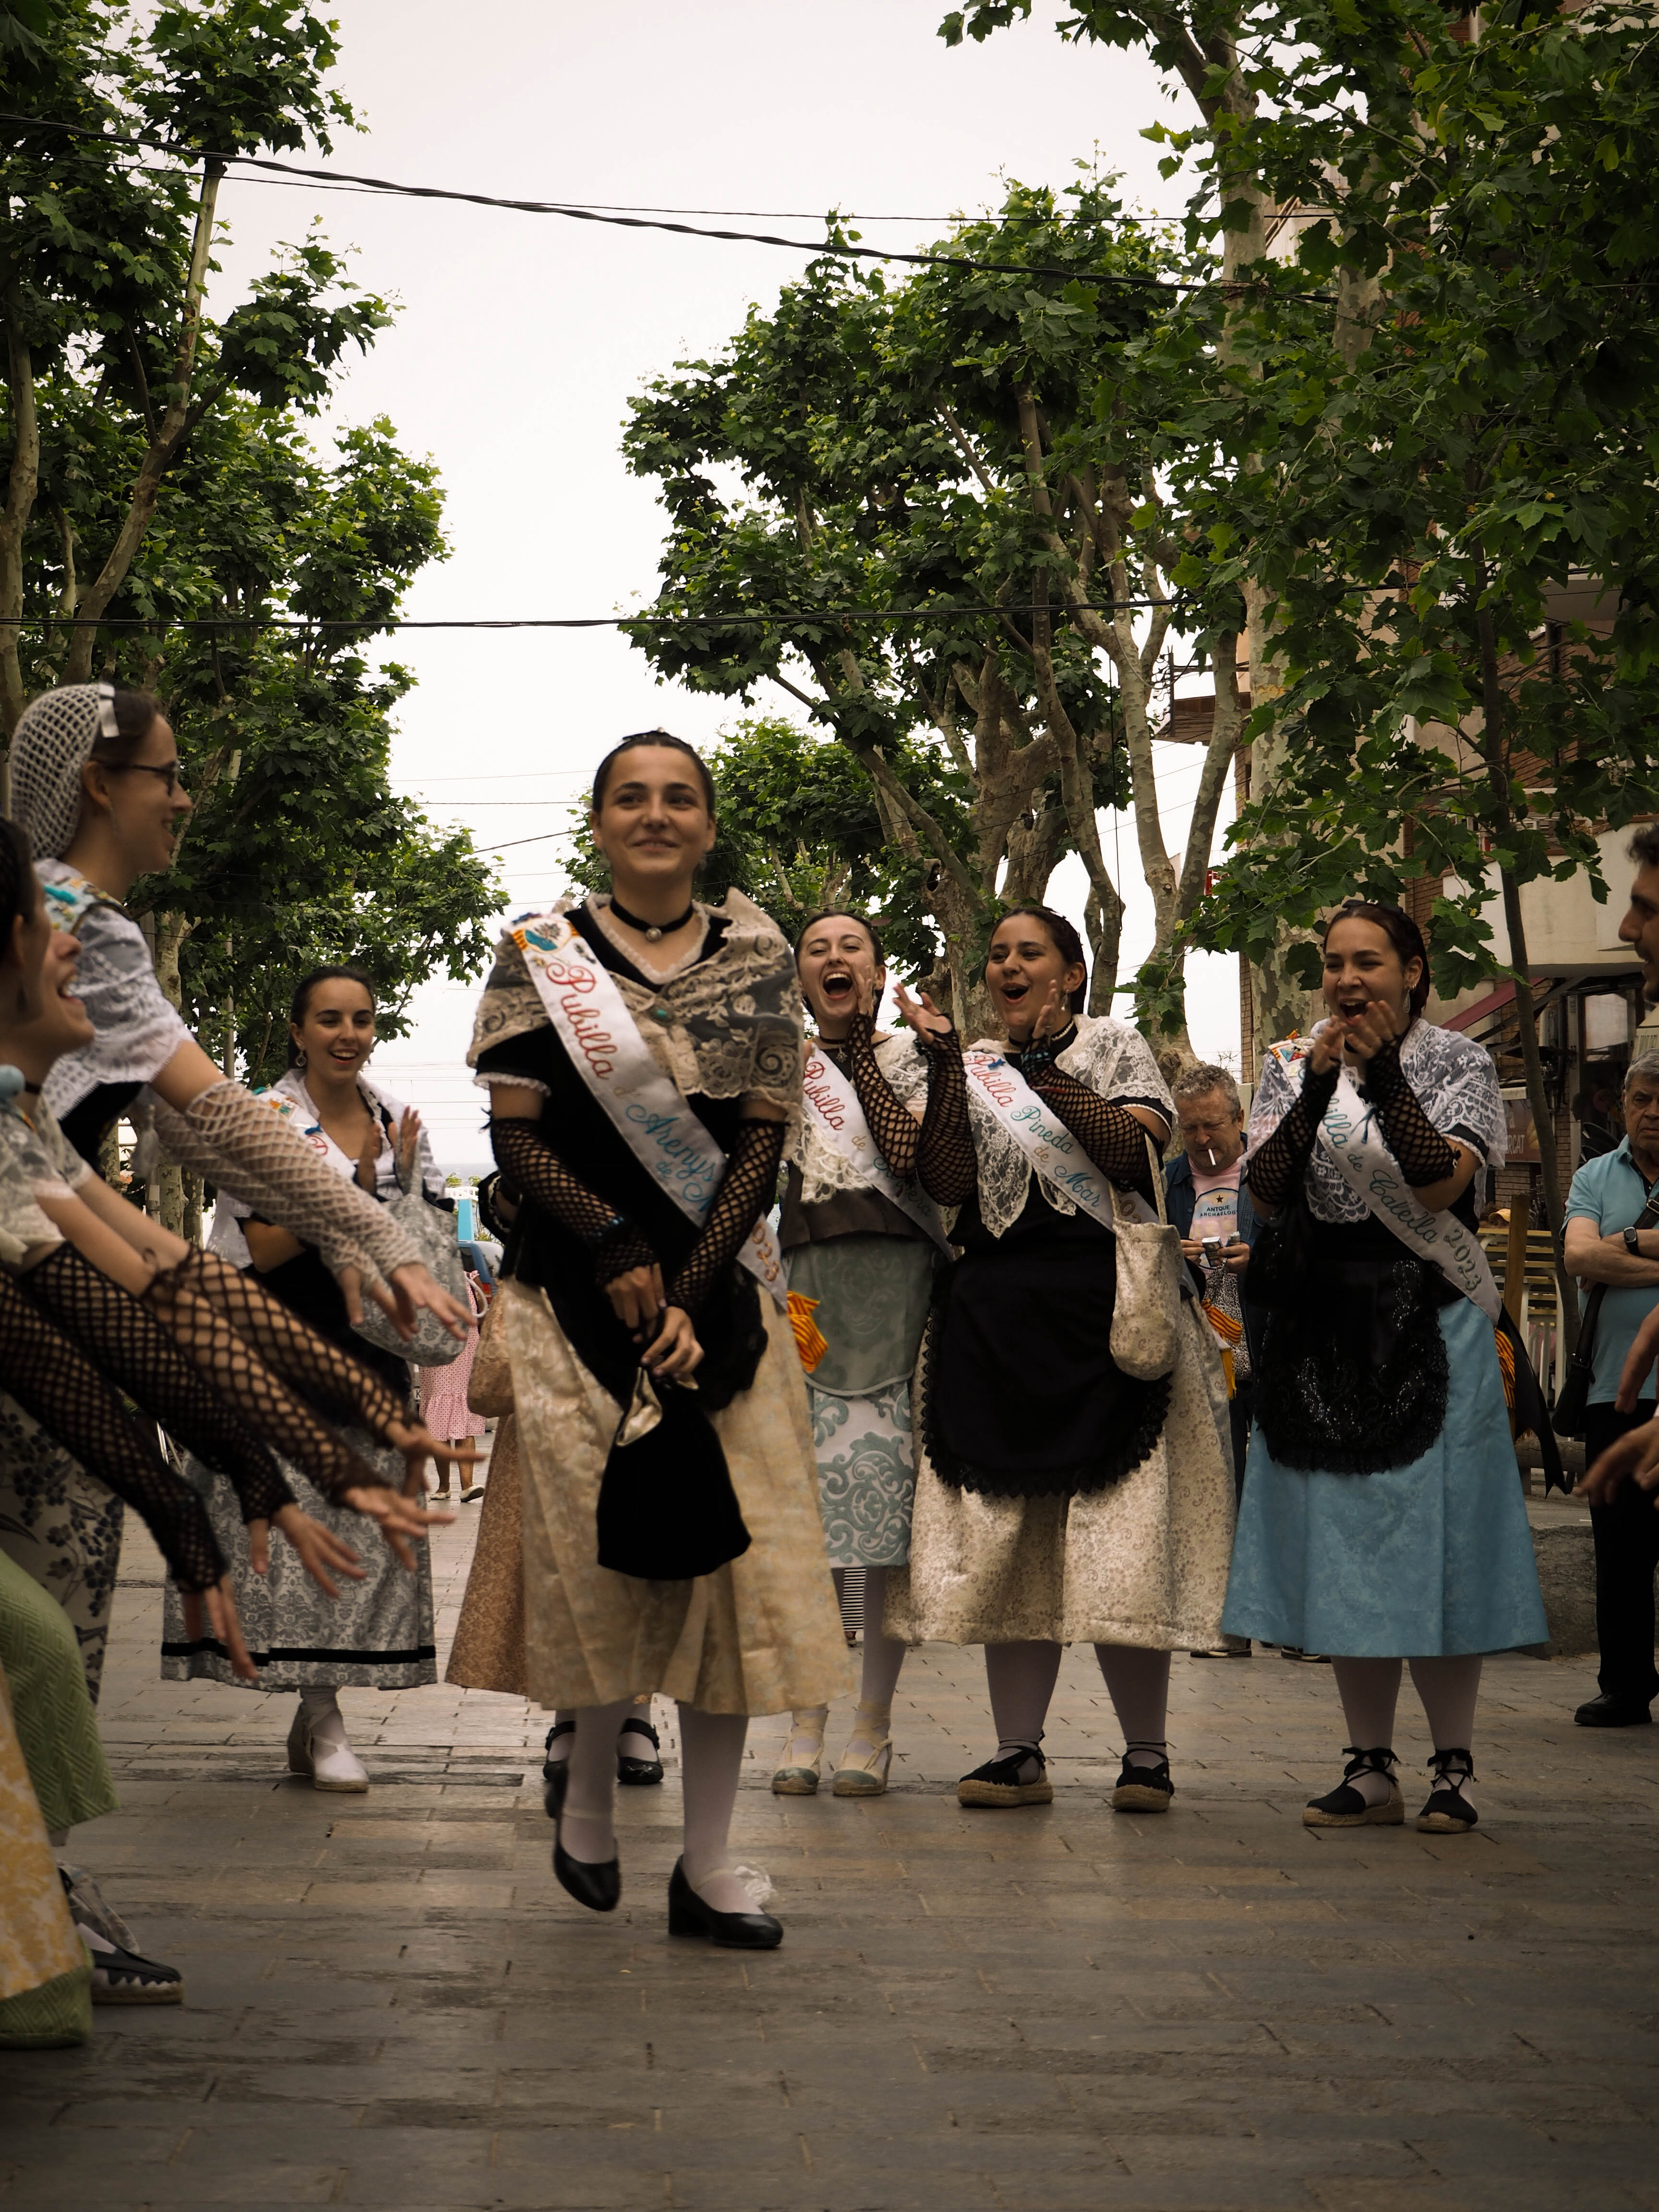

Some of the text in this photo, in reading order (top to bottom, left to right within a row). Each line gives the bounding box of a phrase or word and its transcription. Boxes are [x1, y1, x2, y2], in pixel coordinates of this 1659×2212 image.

[546, 963, 618, 1081] Pubilla
[803, 1061, 845, 1130] Pubilla
[852, 1136, 866, 1151] de
[962, 1055, 1016, 1107] Pubilla
[625, 1105, 715, 1181] Arenys
[1010, 1106, 1074, 1154] Pineda
[1034, 1146, 1049, 1163] de
[1507, 1134, 1525, 1156] RCAT
[656, 1161, 673, 1178] de
[1054, 1166, 1100, 1207] Mar
[1347, 1154, 1364, 1172] de
[1370, 1169, 1437, 1243] Calella
[1444, 1228, 1482, 1291] 2023
[752, 1223, 780, 1282] 023
